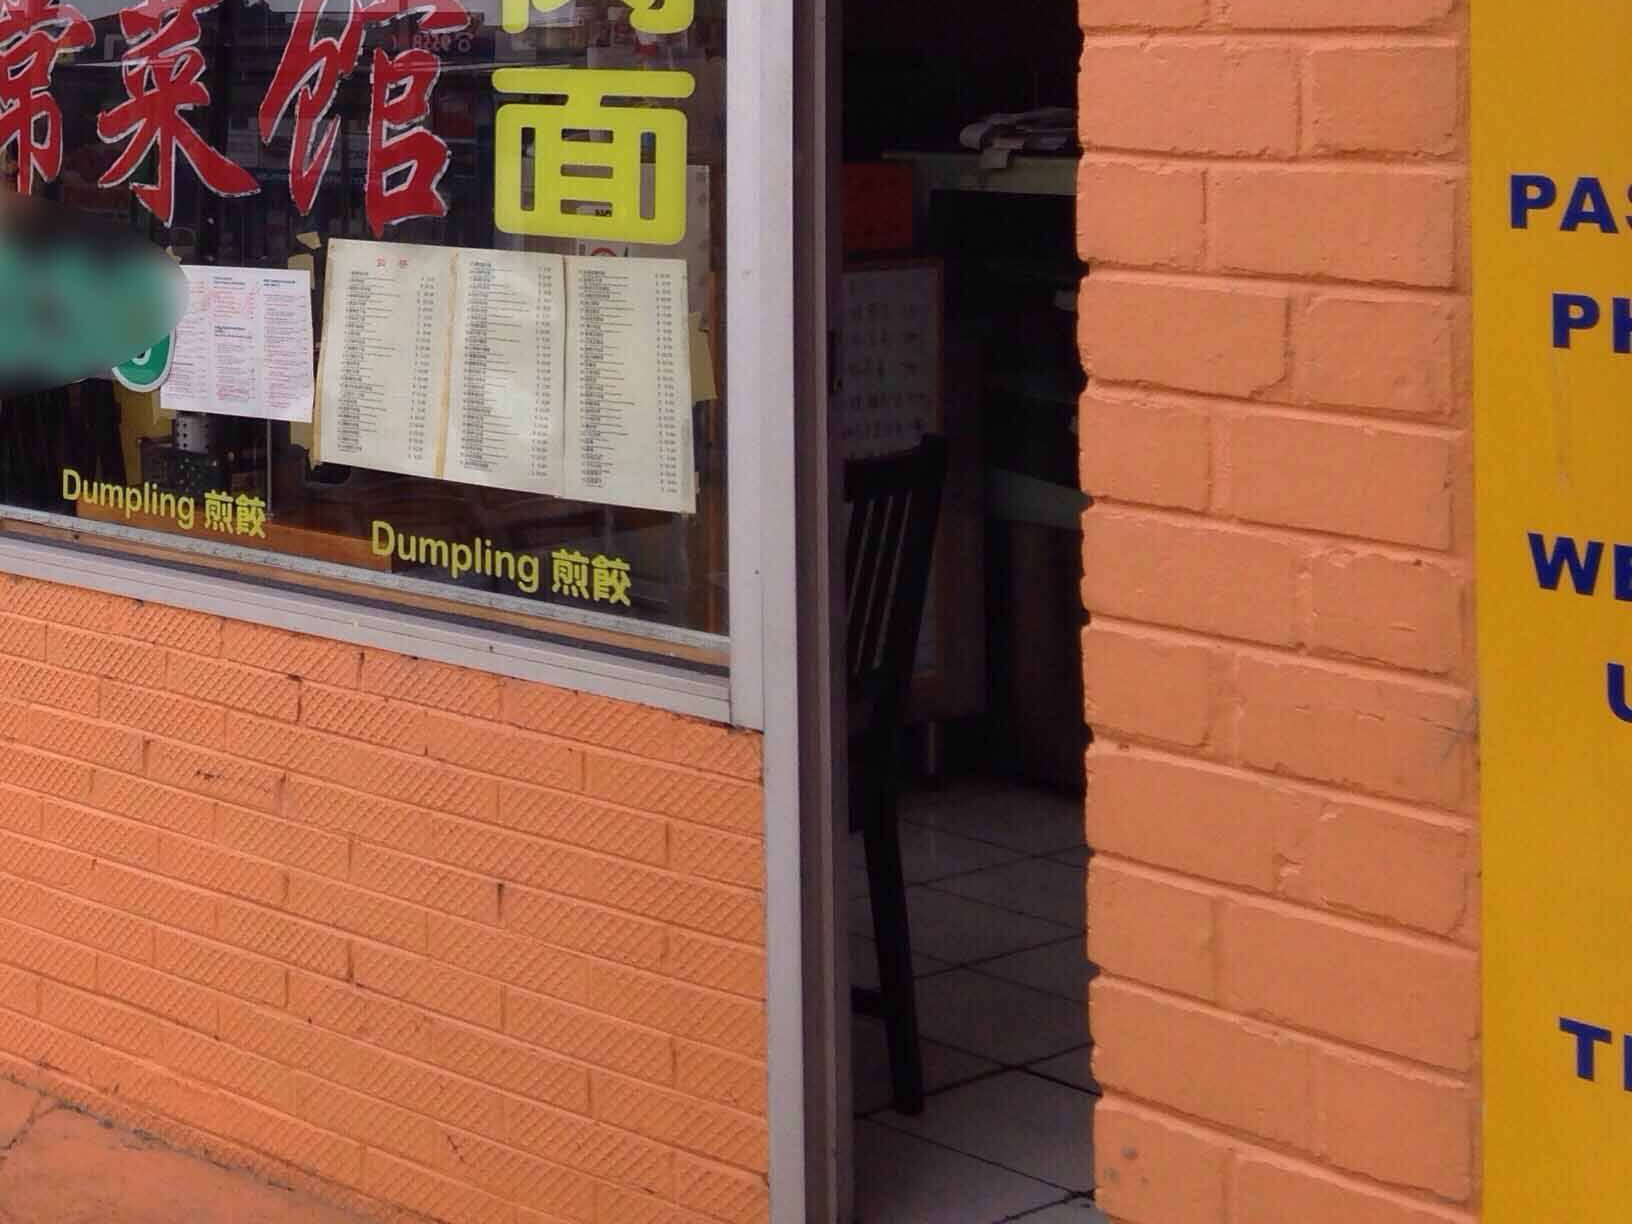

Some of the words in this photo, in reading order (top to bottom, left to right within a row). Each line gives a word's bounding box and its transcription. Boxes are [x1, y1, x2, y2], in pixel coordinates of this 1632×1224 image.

[61, 467, 195, 530] Dumpling
[203, 489, 266, 539] 煎餃
[371, 519, 540, 593] Dumpling
[551, 548, 632, 608] 煎餃
